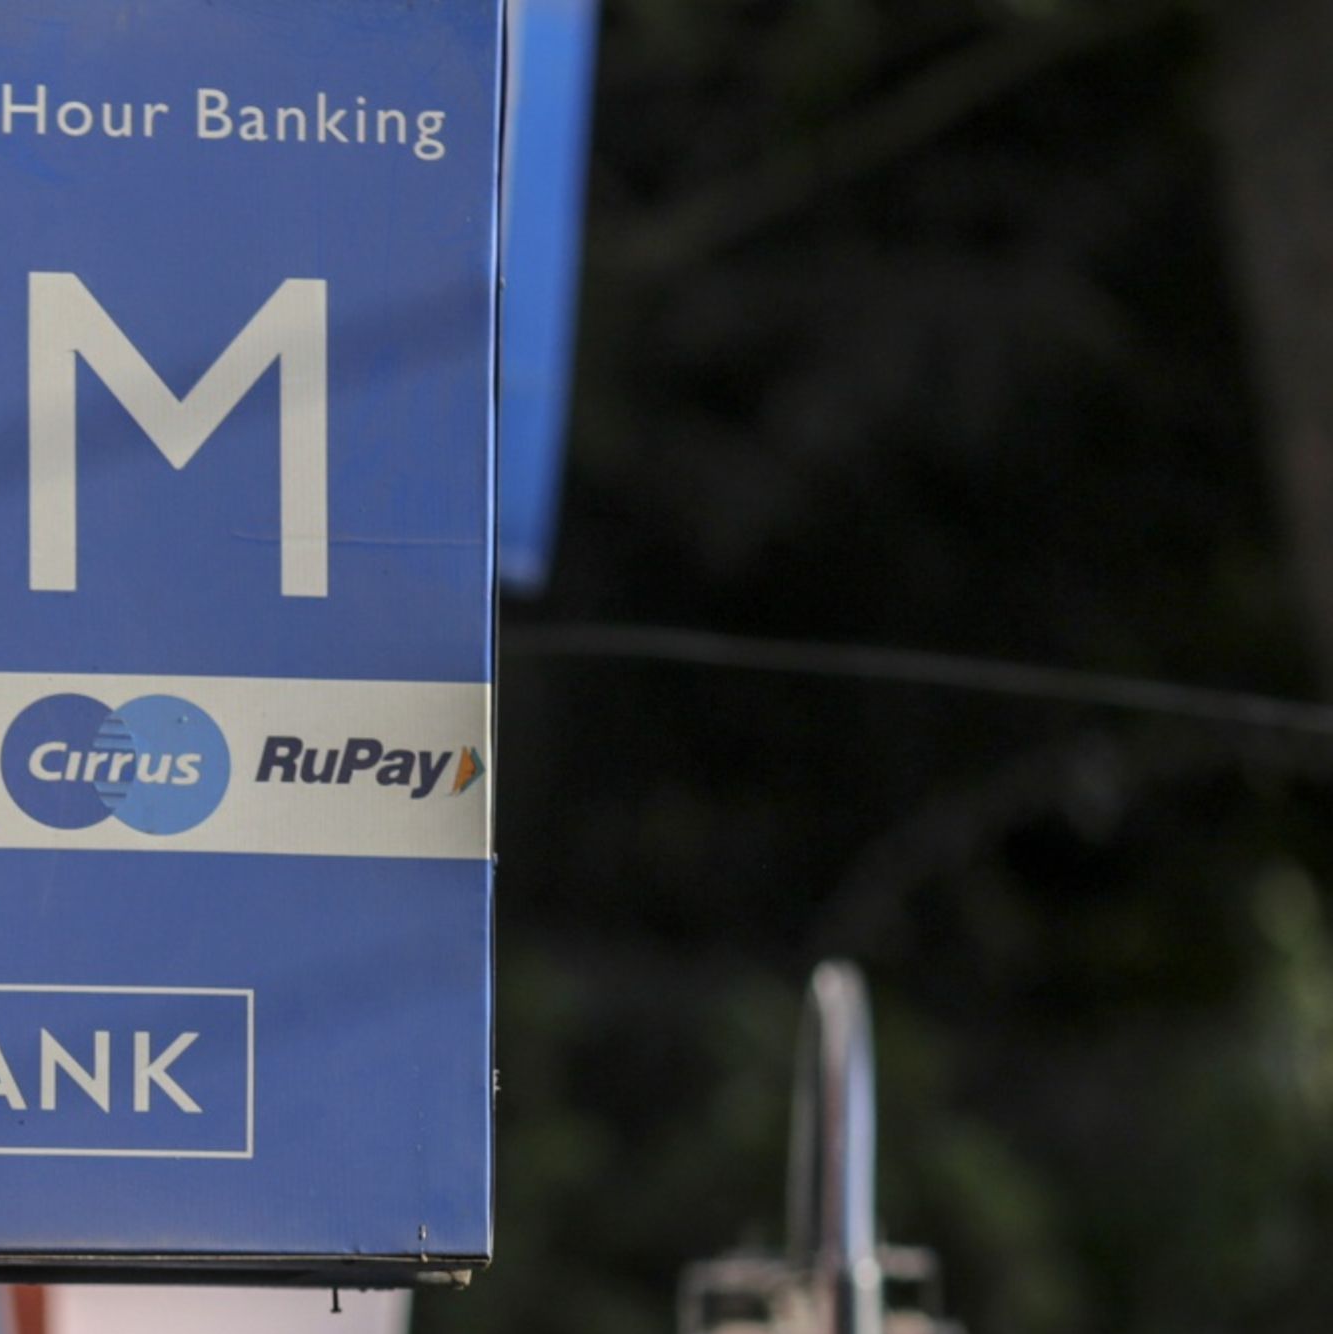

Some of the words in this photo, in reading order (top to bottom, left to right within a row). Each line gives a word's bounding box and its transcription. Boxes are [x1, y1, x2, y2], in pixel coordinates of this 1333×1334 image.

[0, 83, 170, 138] Hour
[196, 88, 447, 162] Banking
[28, 740, 203, 787] Cirrus
[255, 734, 454, 799] RuPay
